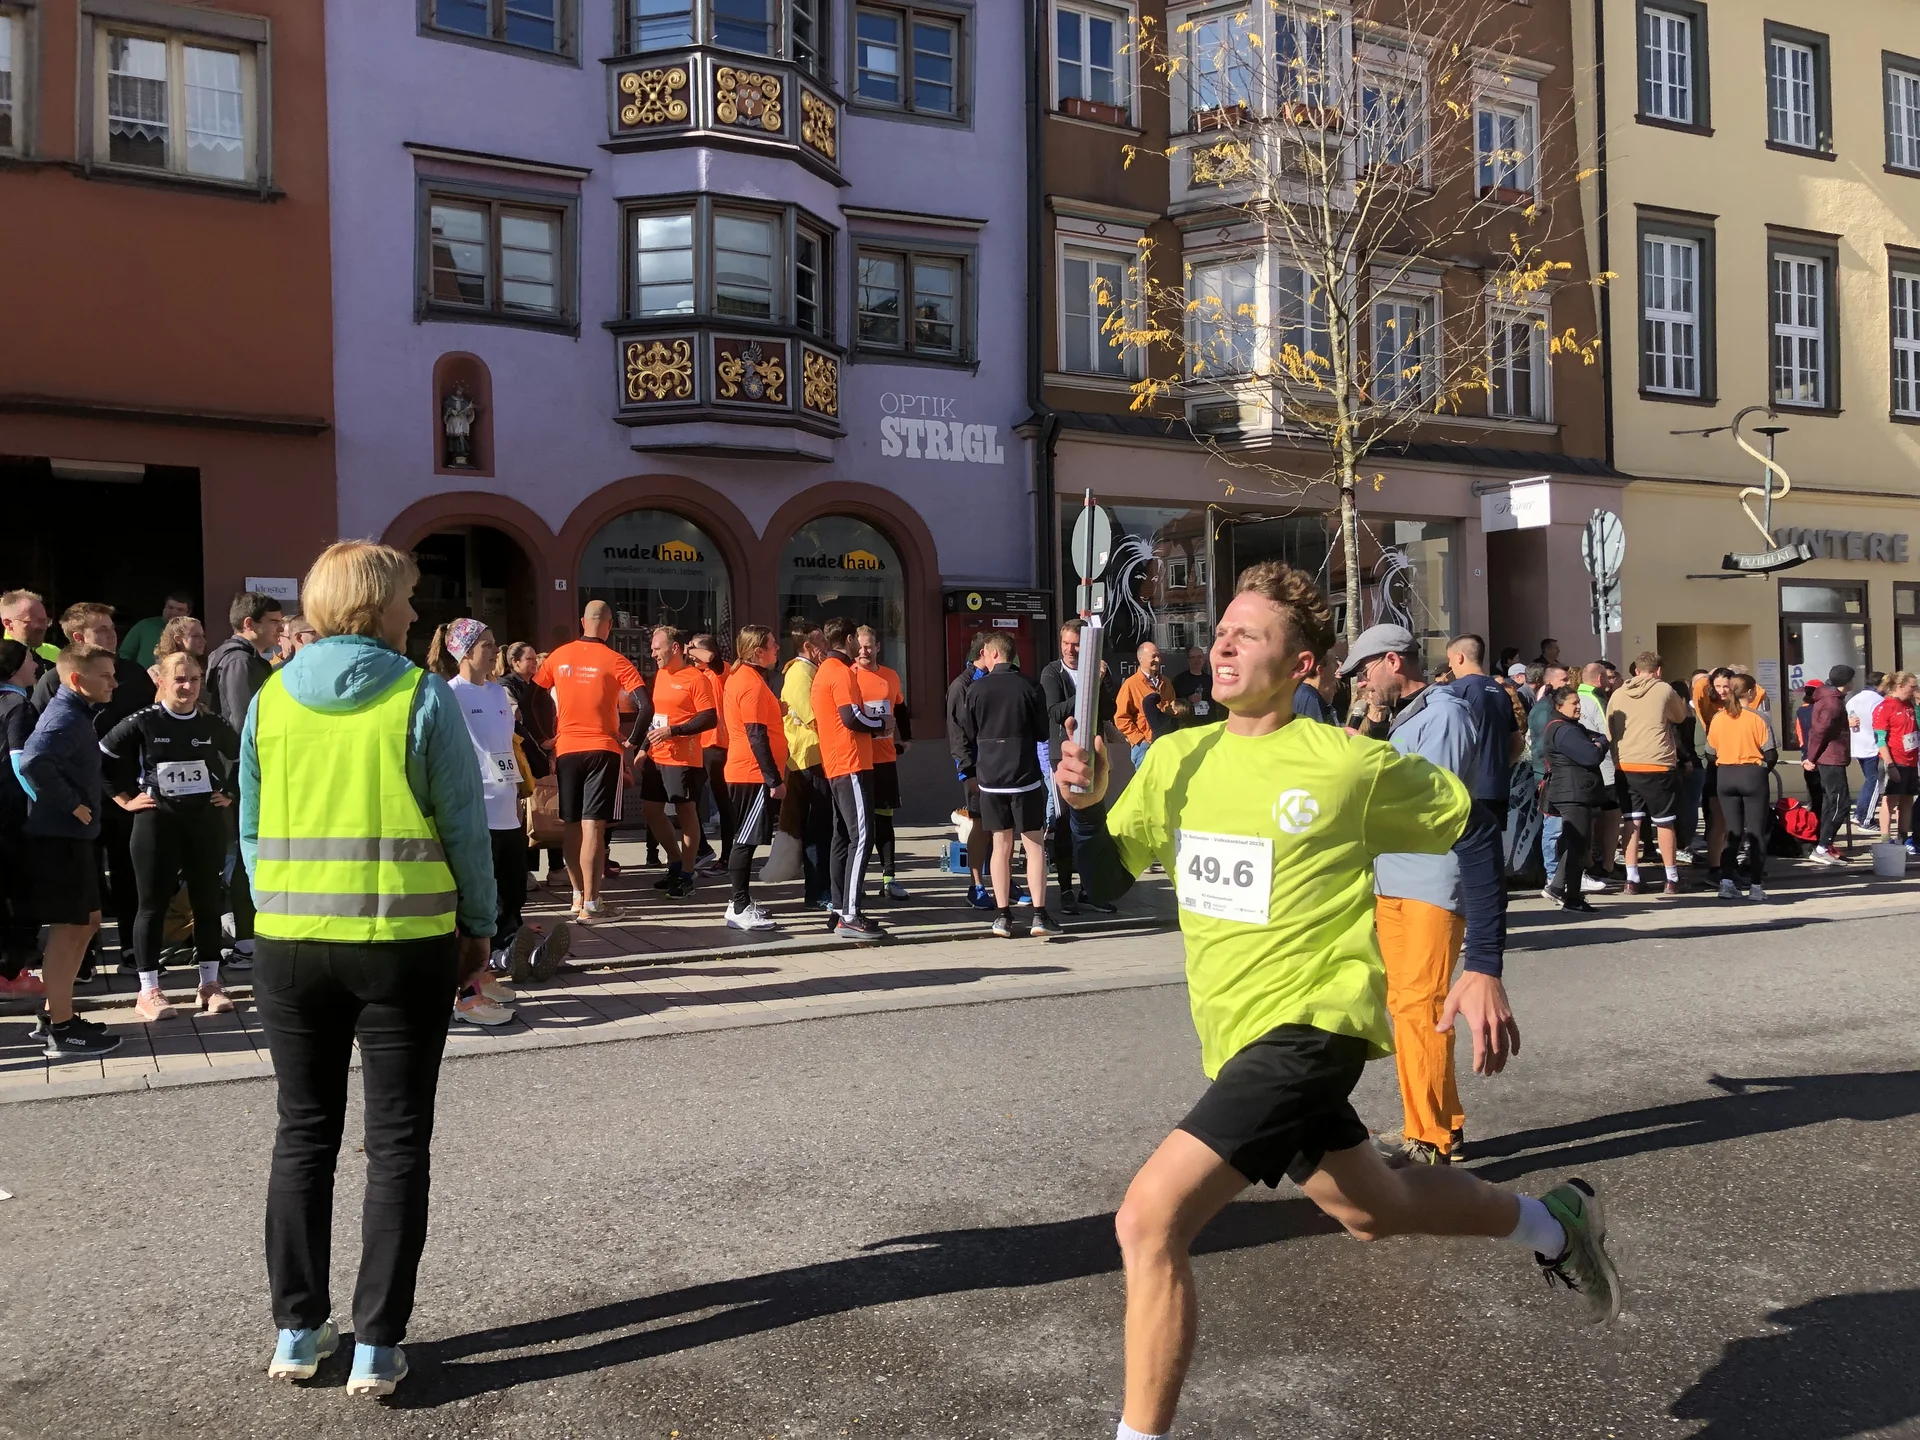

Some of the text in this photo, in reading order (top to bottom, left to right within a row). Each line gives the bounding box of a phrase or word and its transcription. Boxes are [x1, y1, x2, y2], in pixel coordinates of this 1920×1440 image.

[880, 391, 957, 419] OPTIK
[880, 415, 1005, 465] STRIGL
[603, 543, 705, 563] nudelhaus
[793, 553, 886, 571] nudelhaus
[1120, 661, 1166, 675] Frir
[871, 706, 886, 714] 7.3
[498, 759, 514, 771] 9.6
[166, 769, 202, 783] 11.3
[1187, 854, 1254, 888] 49.6
[65, 1037, 86, 1046] HOKA
